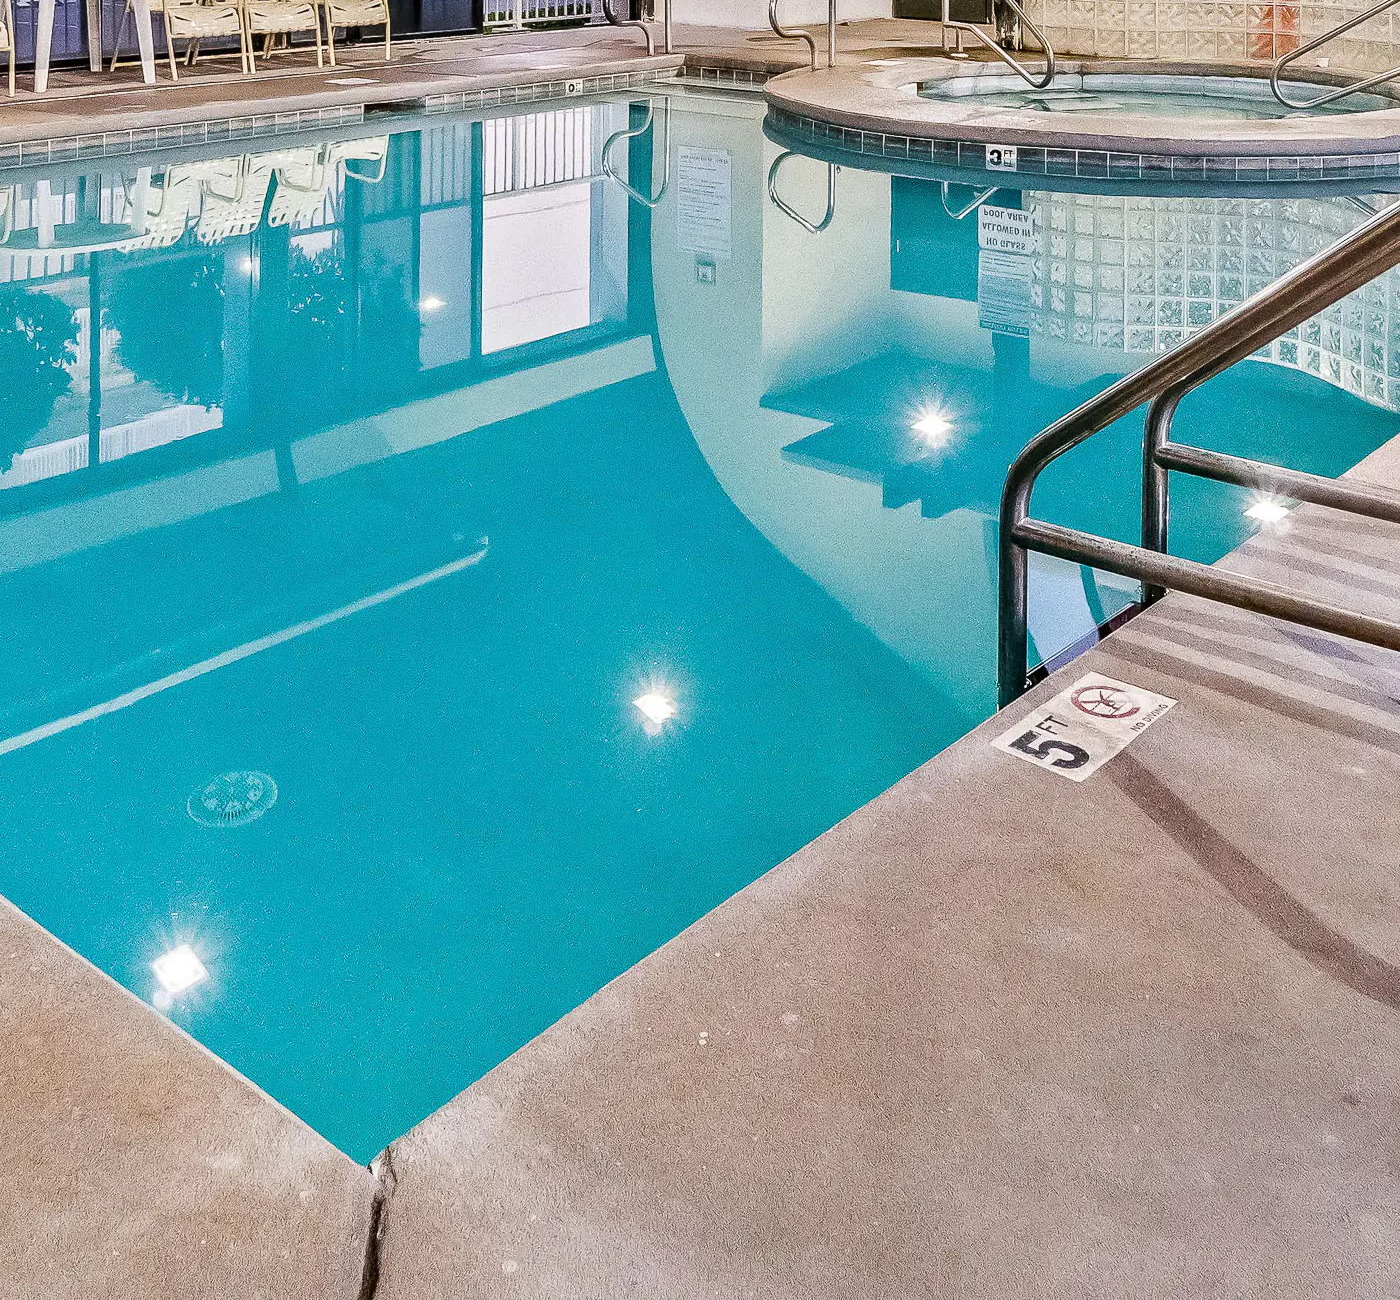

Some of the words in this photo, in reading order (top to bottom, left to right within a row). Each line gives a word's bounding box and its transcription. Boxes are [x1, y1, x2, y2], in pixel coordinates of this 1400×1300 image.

[989, 149, 1002, 166] 3
[1035, 714, 1069, 736] FT
[1129, 722, 1146, 733] NO
[1141, 703, 1169, 723] DIVING
[1008, 729, 1090, 770] 5
